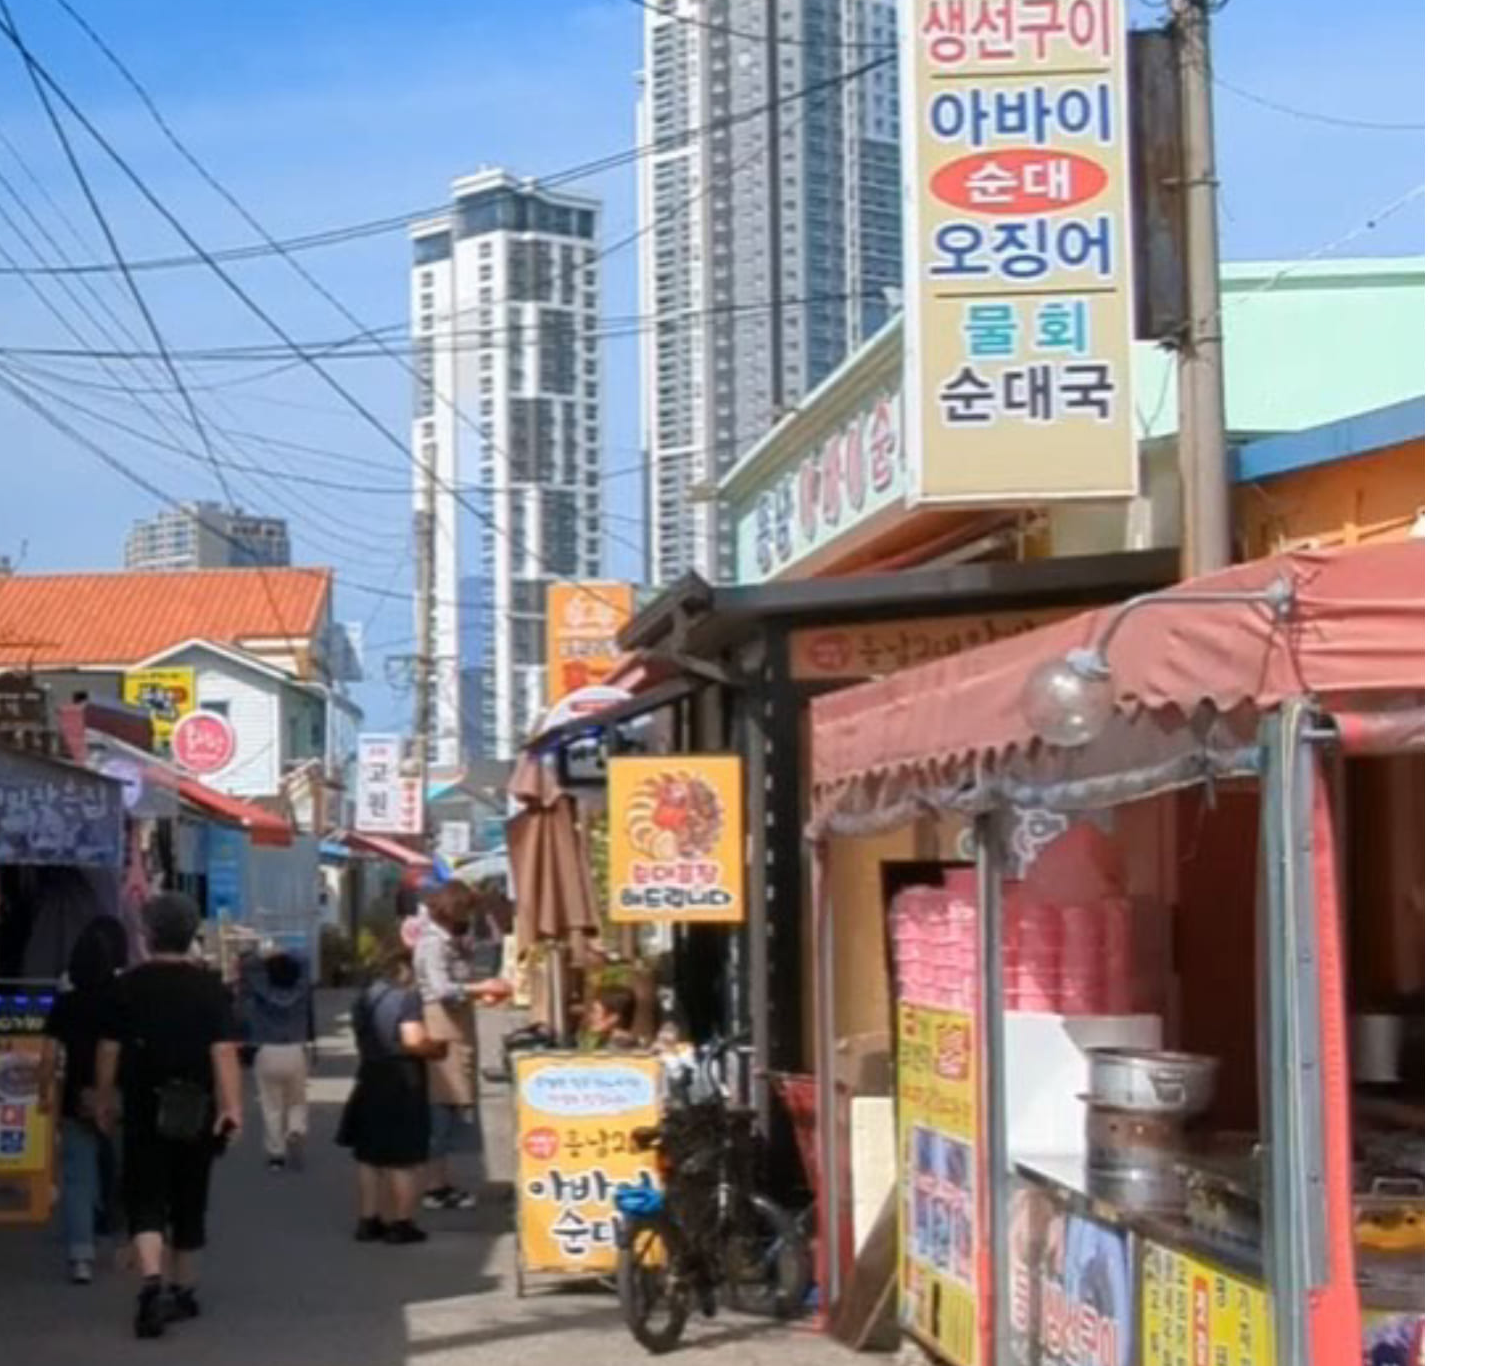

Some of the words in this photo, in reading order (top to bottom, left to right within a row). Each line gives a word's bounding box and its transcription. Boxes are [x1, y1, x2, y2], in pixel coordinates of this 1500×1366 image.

[930, 86, 1110, 146] 아바이
[964, 159, 1071, 204] 순대
[930, 217, 1111, 277] 오징어
[964, 302, 1087, 354] 물회
[939, 363, 1114, 422] 순대국
